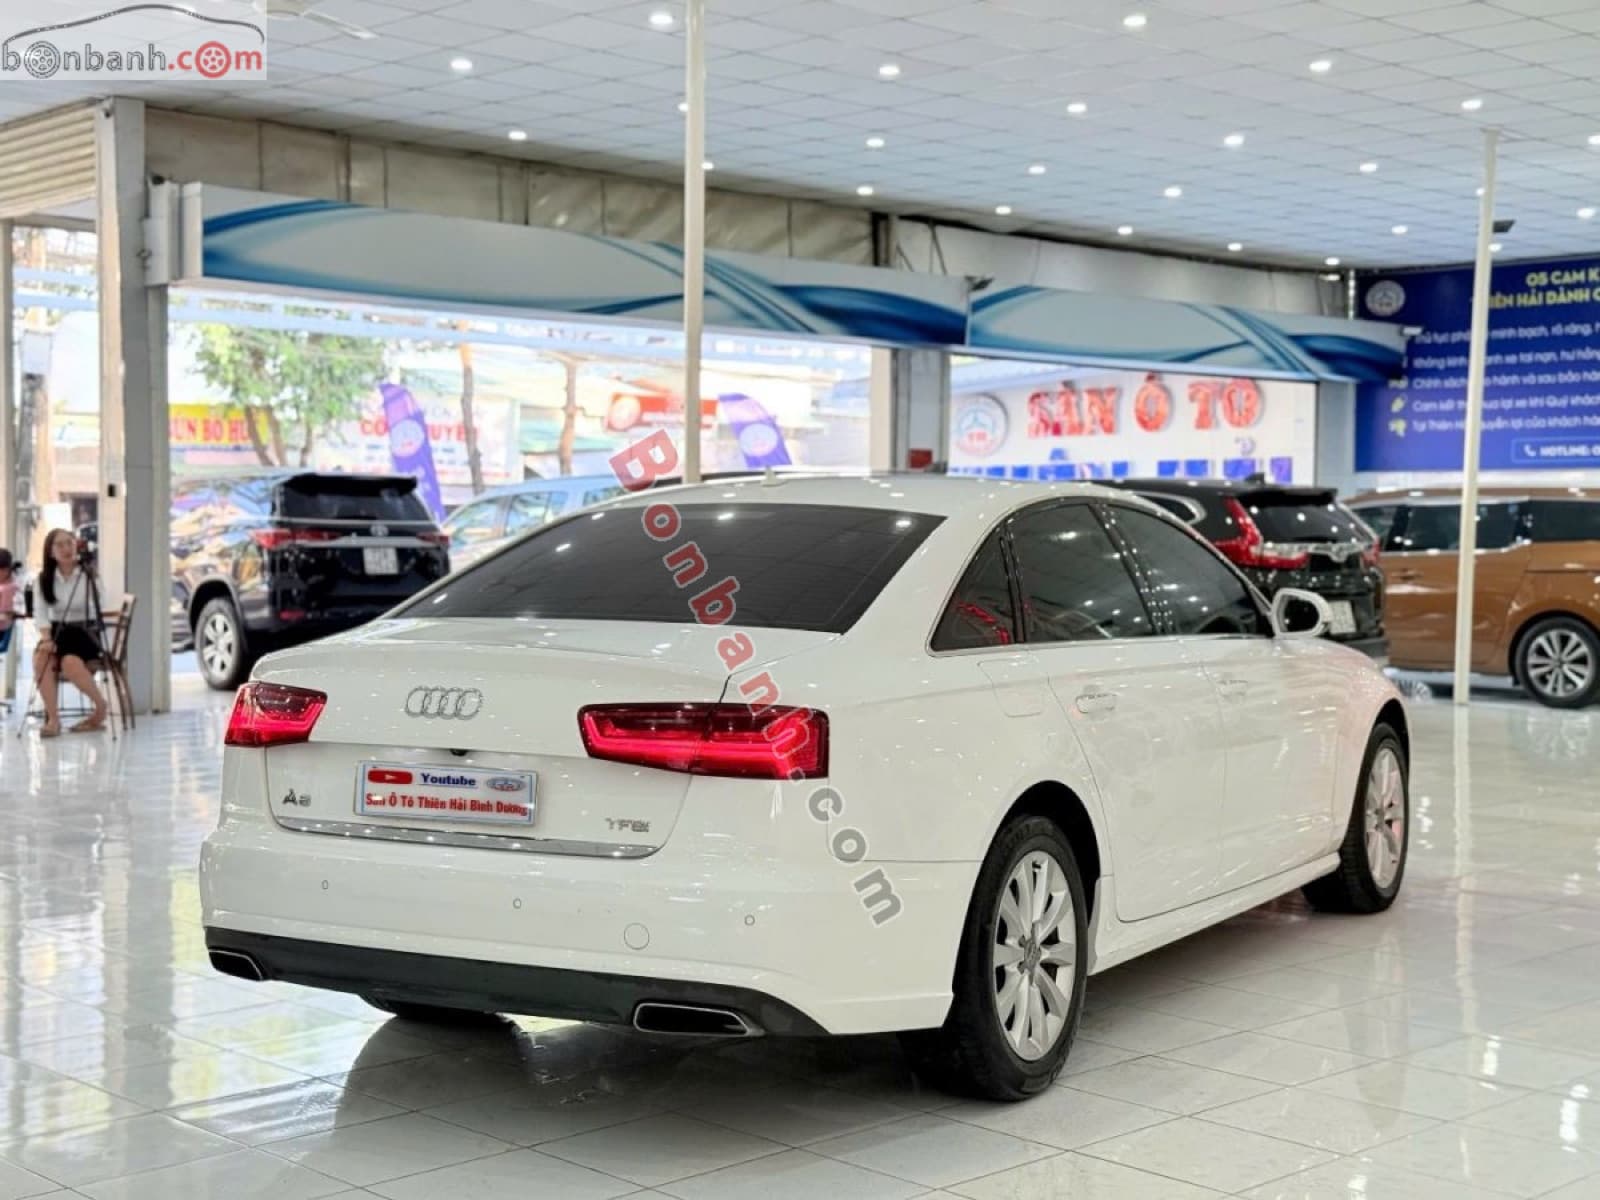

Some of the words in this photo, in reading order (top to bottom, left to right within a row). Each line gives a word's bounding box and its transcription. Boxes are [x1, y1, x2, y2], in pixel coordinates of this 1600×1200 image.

[1551, 268, 1586, 285] CAM
[420, 773, 477, 787] Youtube
[417, 796, 447, 810] Thiên
